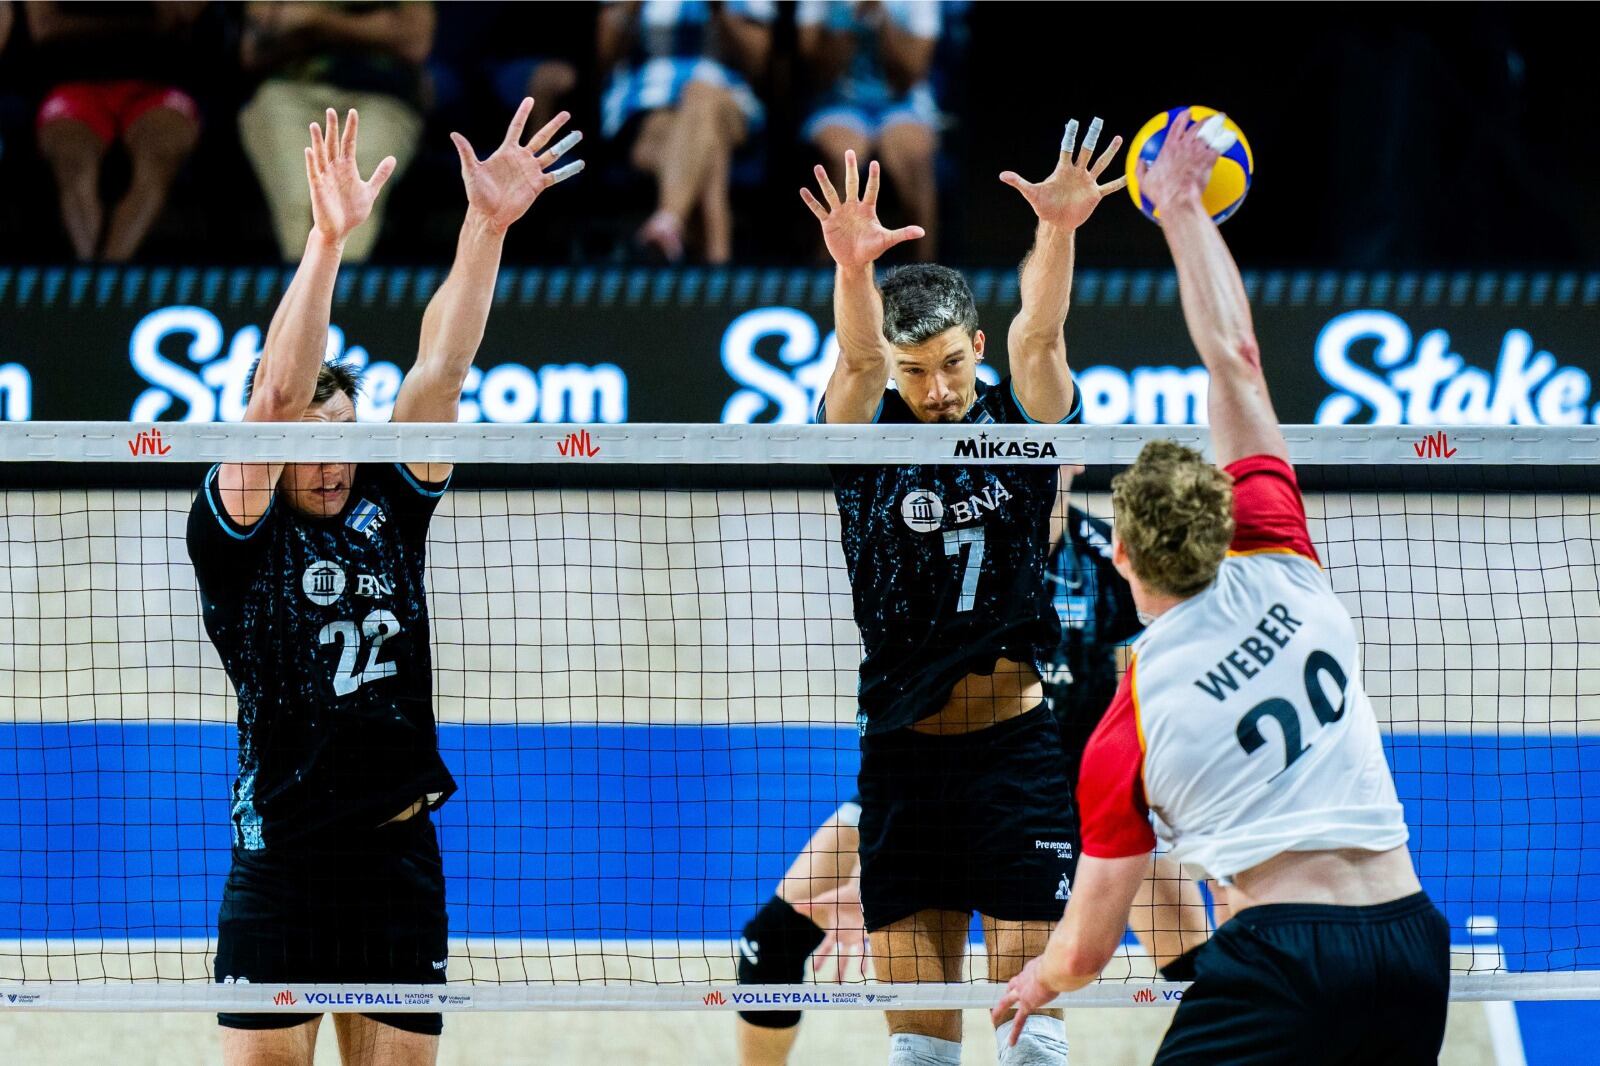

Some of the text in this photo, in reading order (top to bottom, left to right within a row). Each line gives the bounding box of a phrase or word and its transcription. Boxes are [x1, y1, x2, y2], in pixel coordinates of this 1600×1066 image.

[129, 427, 171, 457] VNL
[557, 428, 600, 458] VNL
[1414, 430, 1457, 459] VNL
[950, 480, 1013, 524] BNA
[942, 525, 986, 613] 7
[355, 572, 397, 599] BN
[318, 608, 401, 697] 22
[1194, 602, 1303, 702] WEBER
[1236, 650, 1348, 784] 20
[273, 989, 402, 1006] VNL VOLLEYBALL
[702, 990, 830, 1006] VNL VOLLEYBALL
[1132, 988, 1158, 1003] VNL
